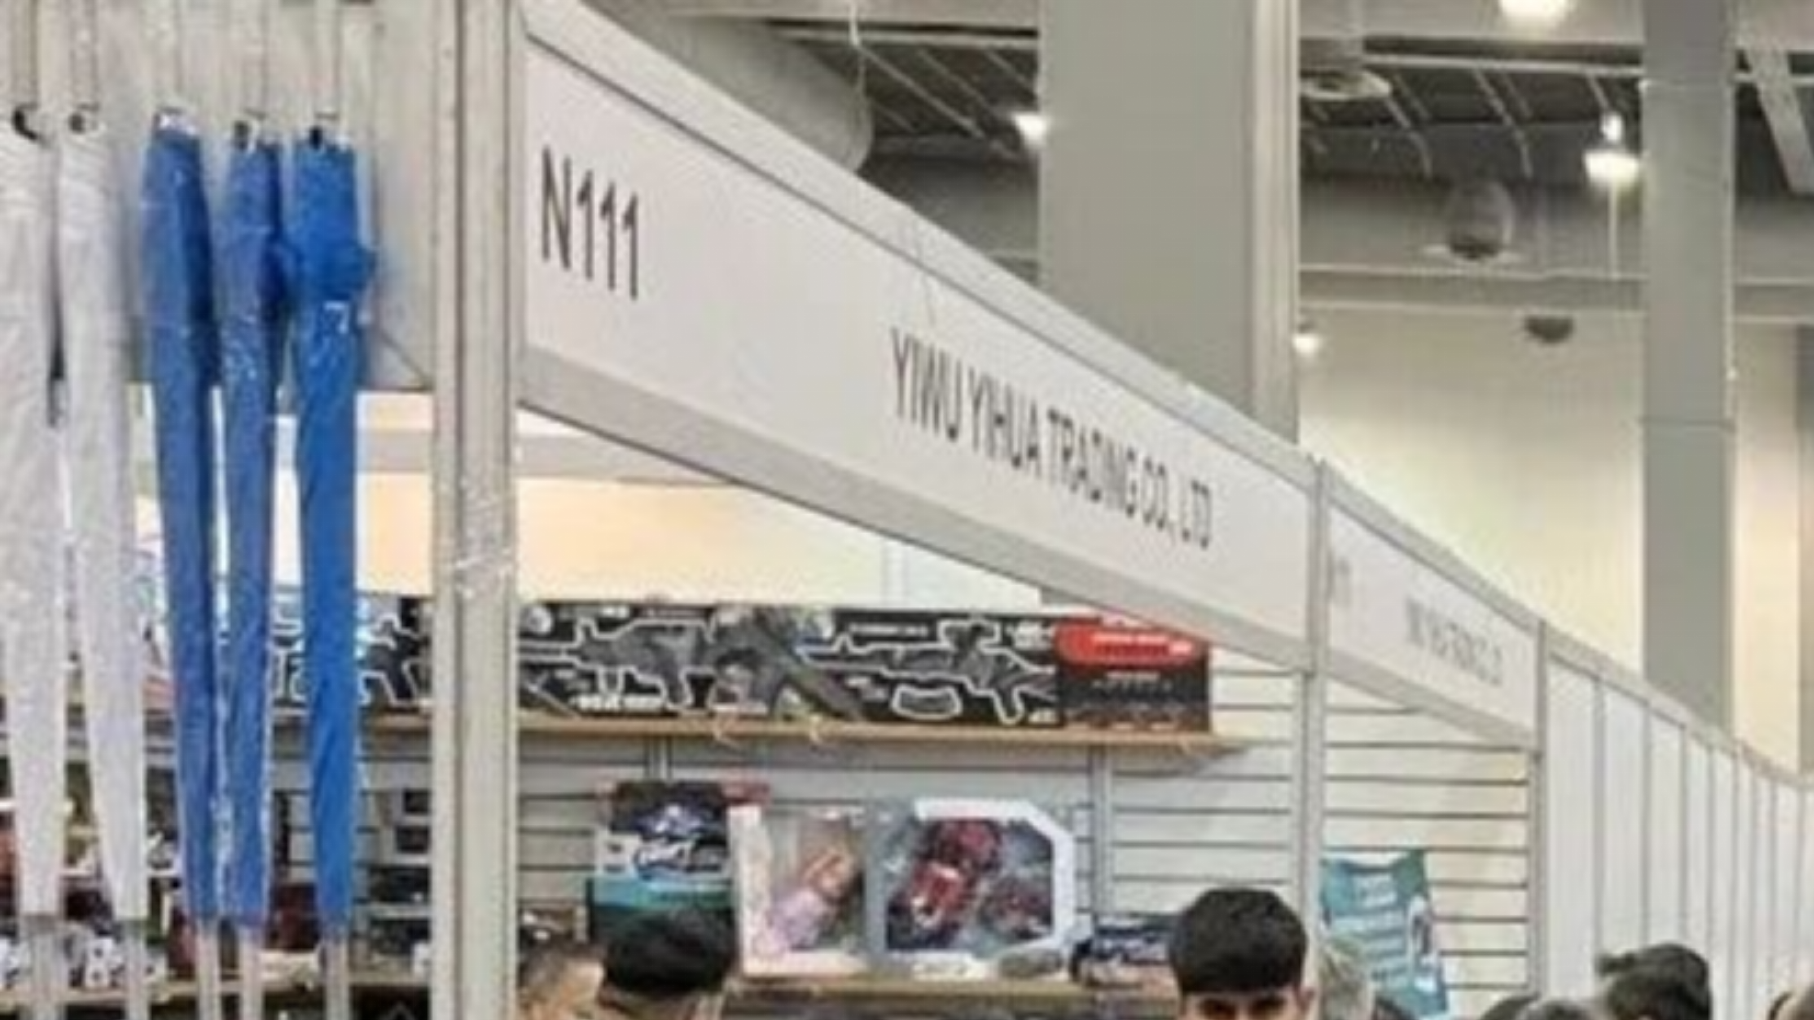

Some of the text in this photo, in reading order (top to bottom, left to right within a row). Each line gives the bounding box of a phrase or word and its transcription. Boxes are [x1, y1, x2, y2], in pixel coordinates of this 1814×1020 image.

[541, 145, 638, 300] N111
[891, 326, 963, 443] YIWU
[968, 366, 1042, 480] YIHUA
[1047, 408, 1138, 518] TRADING
[1179, 477, 1212, 550] LTD
